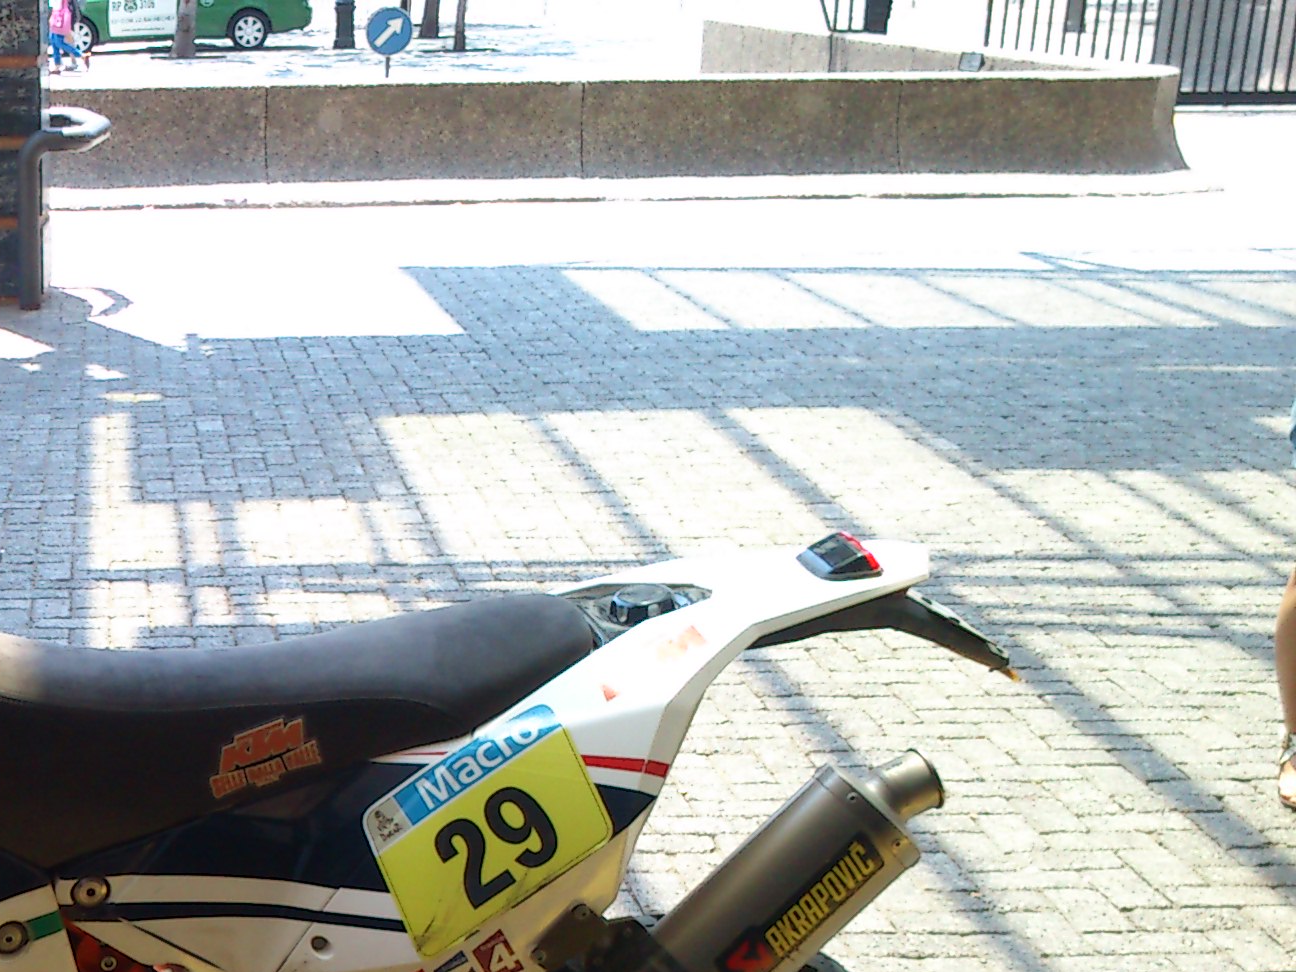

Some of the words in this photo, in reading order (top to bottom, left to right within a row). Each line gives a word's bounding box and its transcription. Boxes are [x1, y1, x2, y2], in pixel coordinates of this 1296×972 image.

[219, 718, 304, 775] KTM
[413, 715, 542, 811] Macro
[434, 786, 558, 910] 29
